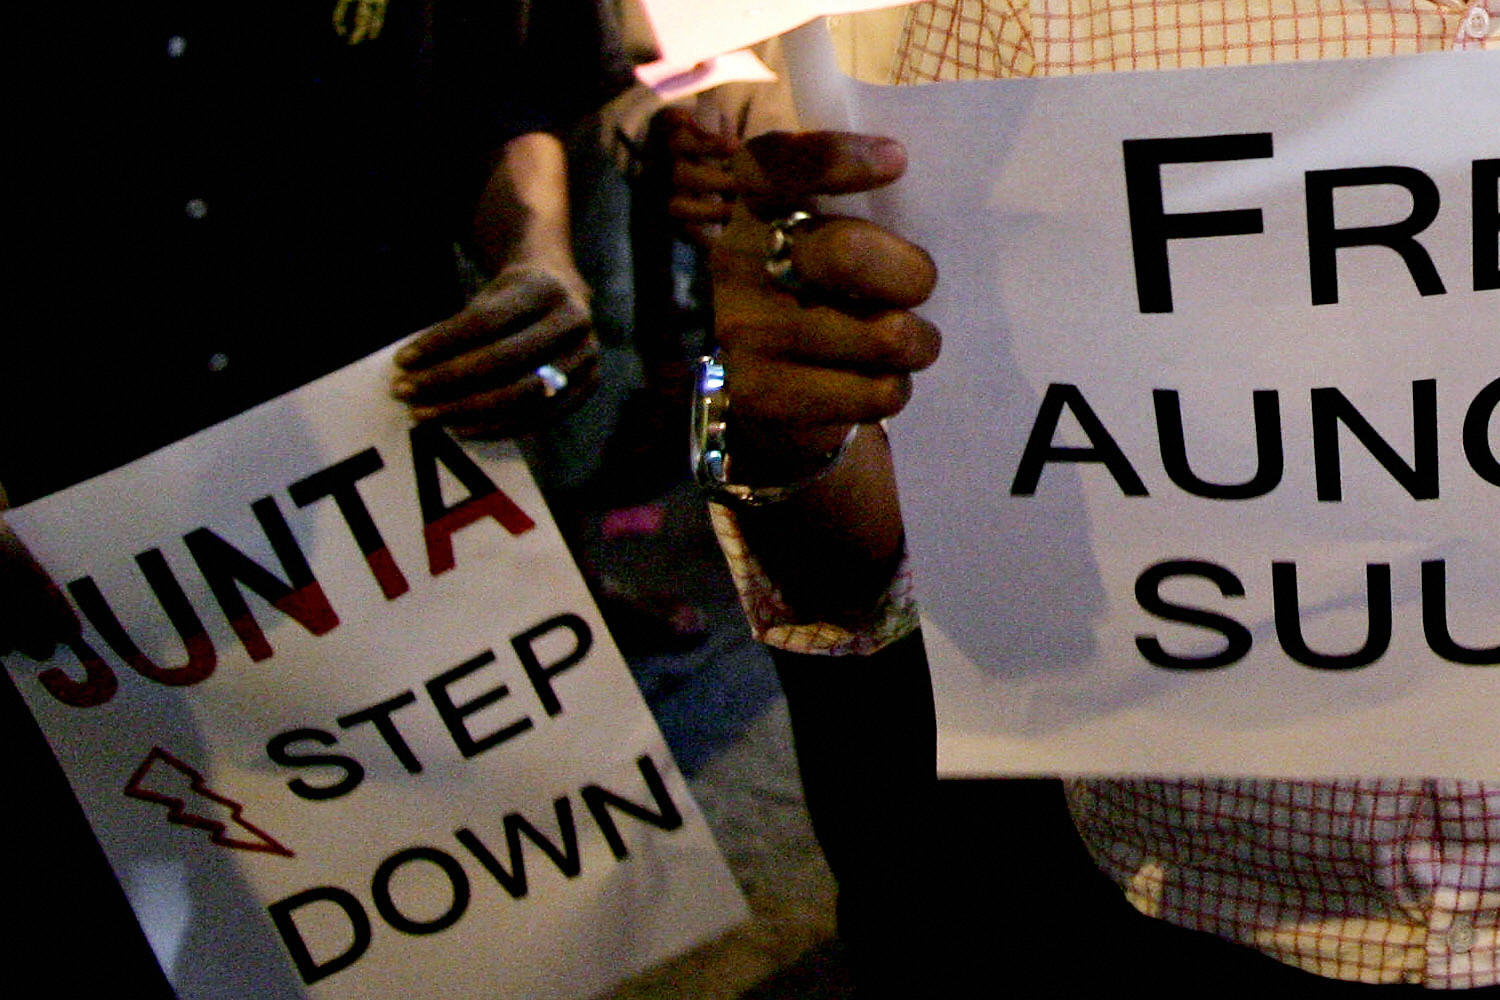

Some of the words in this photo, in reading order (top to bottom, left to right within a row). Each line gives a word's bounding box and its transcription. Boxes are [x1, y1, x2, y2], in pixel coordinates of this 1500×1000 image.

[38, 419, 536, 708] JUNTA
[266, 612, 594, 802] STEP
[267, 754, 684, 986] DOWN
